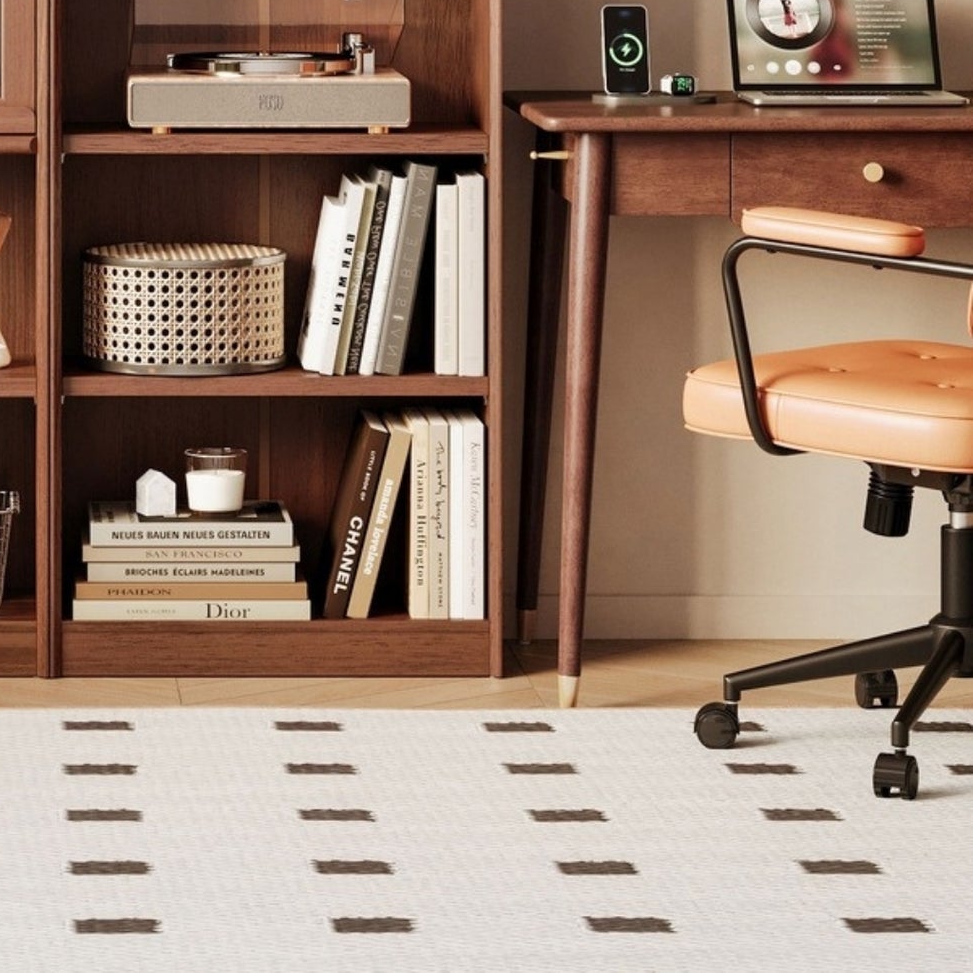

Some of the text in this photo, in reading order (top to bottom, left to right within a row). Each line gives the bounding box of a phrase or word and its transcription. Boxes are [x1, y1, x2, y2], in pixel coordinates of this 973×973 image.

[360, 450, 376, 501] LITTLE BOOK OF
[363, 478, 394, 575] amanda lovelace
[415, 459, 427, 586] Arianna Huffington
[111, 531, 270, 540] NEUES BAUEN NEUES GESTALTEN
[145, 550, 243, 558] SAN FRANCISCO
[333, 516, 363, 594] CHANEL
[173, 567, 207, 576] ÉCLAIRS
[107, 588, 171, 596] PHAIDON
[206, 603, 251, 619] Dior
